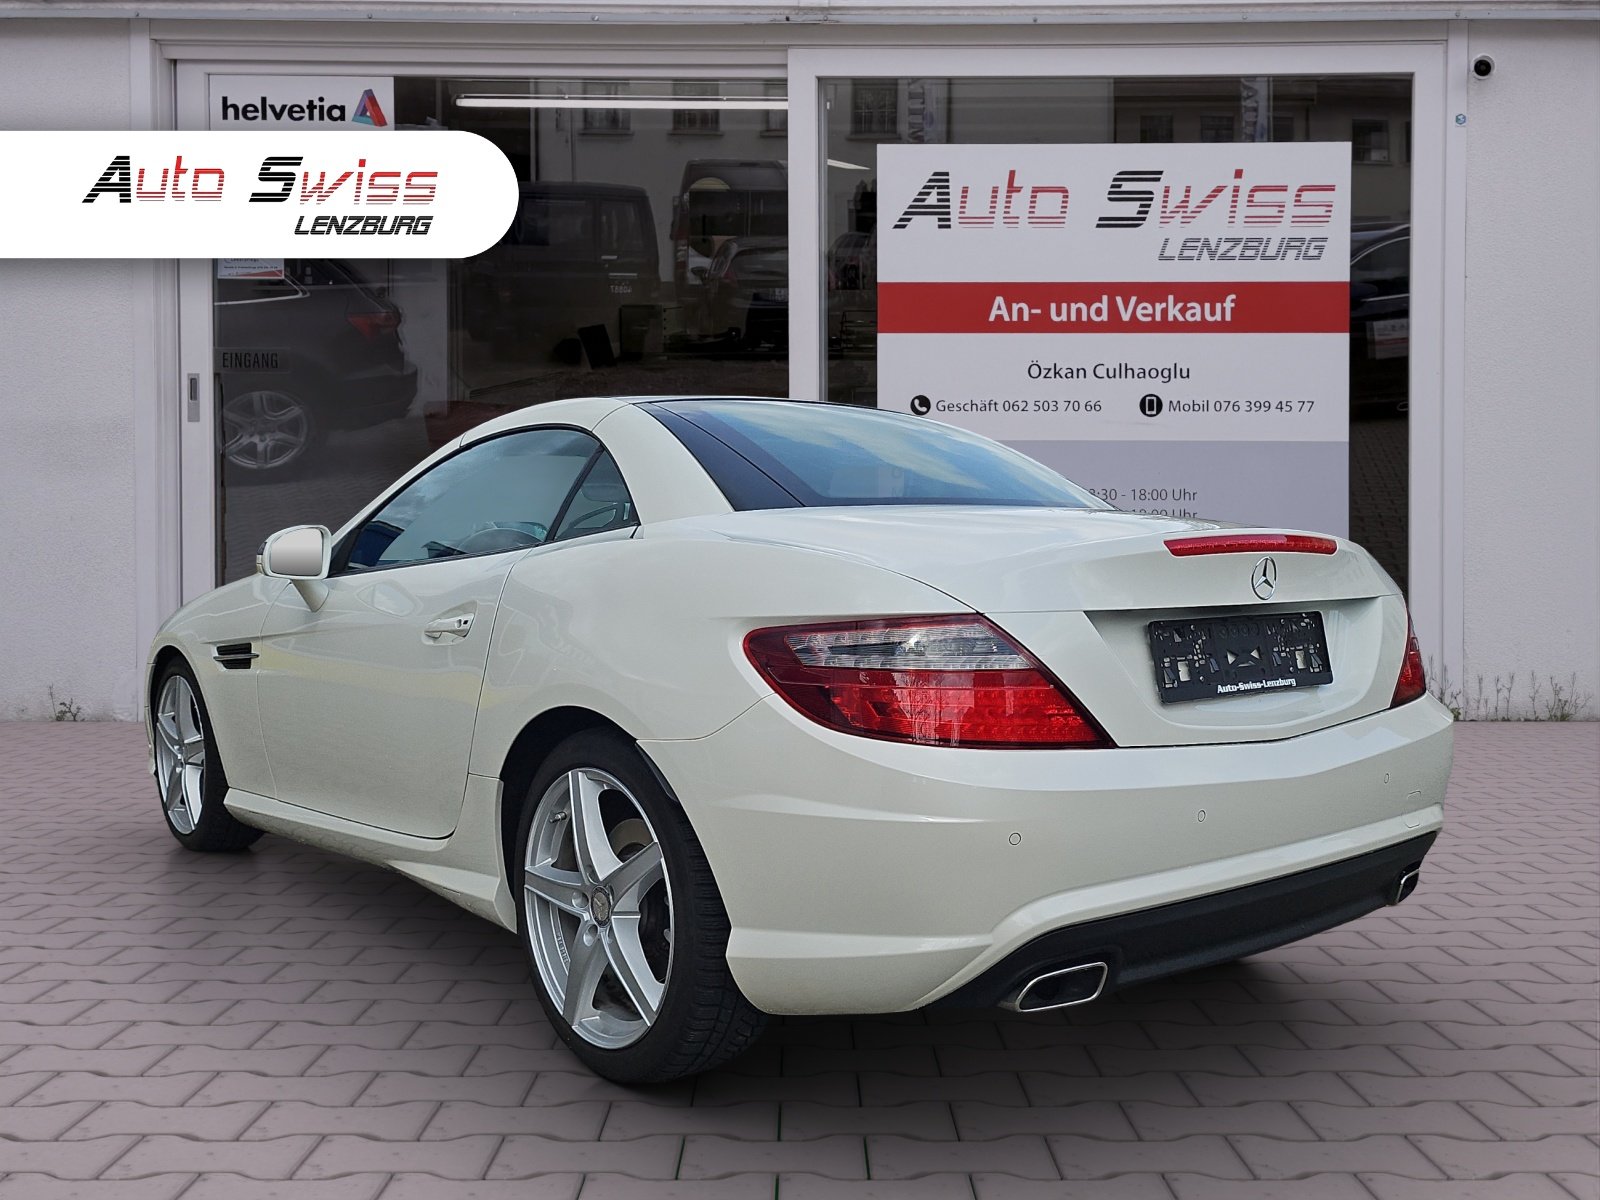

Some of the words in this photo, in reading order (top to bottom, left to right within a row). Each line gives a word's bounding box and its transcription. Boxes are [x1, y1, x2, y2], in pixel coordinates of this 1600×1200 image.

[221, 95, 346, 122] helvetia
[892, 169, 1070, 229] Auto
[1095, 168, 1336, 228] Swiss
[1157, 237, 1329, 261] LENZBURG
[988, 296, 1042, 322] An-
[1050, 295, 1108, 322] und
[1115, 295, 1237, 322] Verkauf
[221, 352, 280, 369] EINGANG
[1027, 360, 1087, 380] Özkan
[1093, 362, 1190, 384] Culhaoglu
[936, 399, 998, 413] Geschäft
[1003, 400, 1029, 413] 062
[1033, 400, 1059, 413] 503
[1063, 400, 1081, 413] 70
[1084, 400, 1102, 413] 66
[1168, 399, 1210, 413] Mobil
[1213, 400, 1241, 413] 076
[1244, 400, 1272, 413] 399
[1274, 400, 1293, 413] 45
[1297, 400, 1315, 413] 77
[1131, 488, 1168, 501] 18:00
[1172, 488, 1198, 501] Uhr
[1217, 677, 1297, 694] Auto-Swiss-Lenzburg
